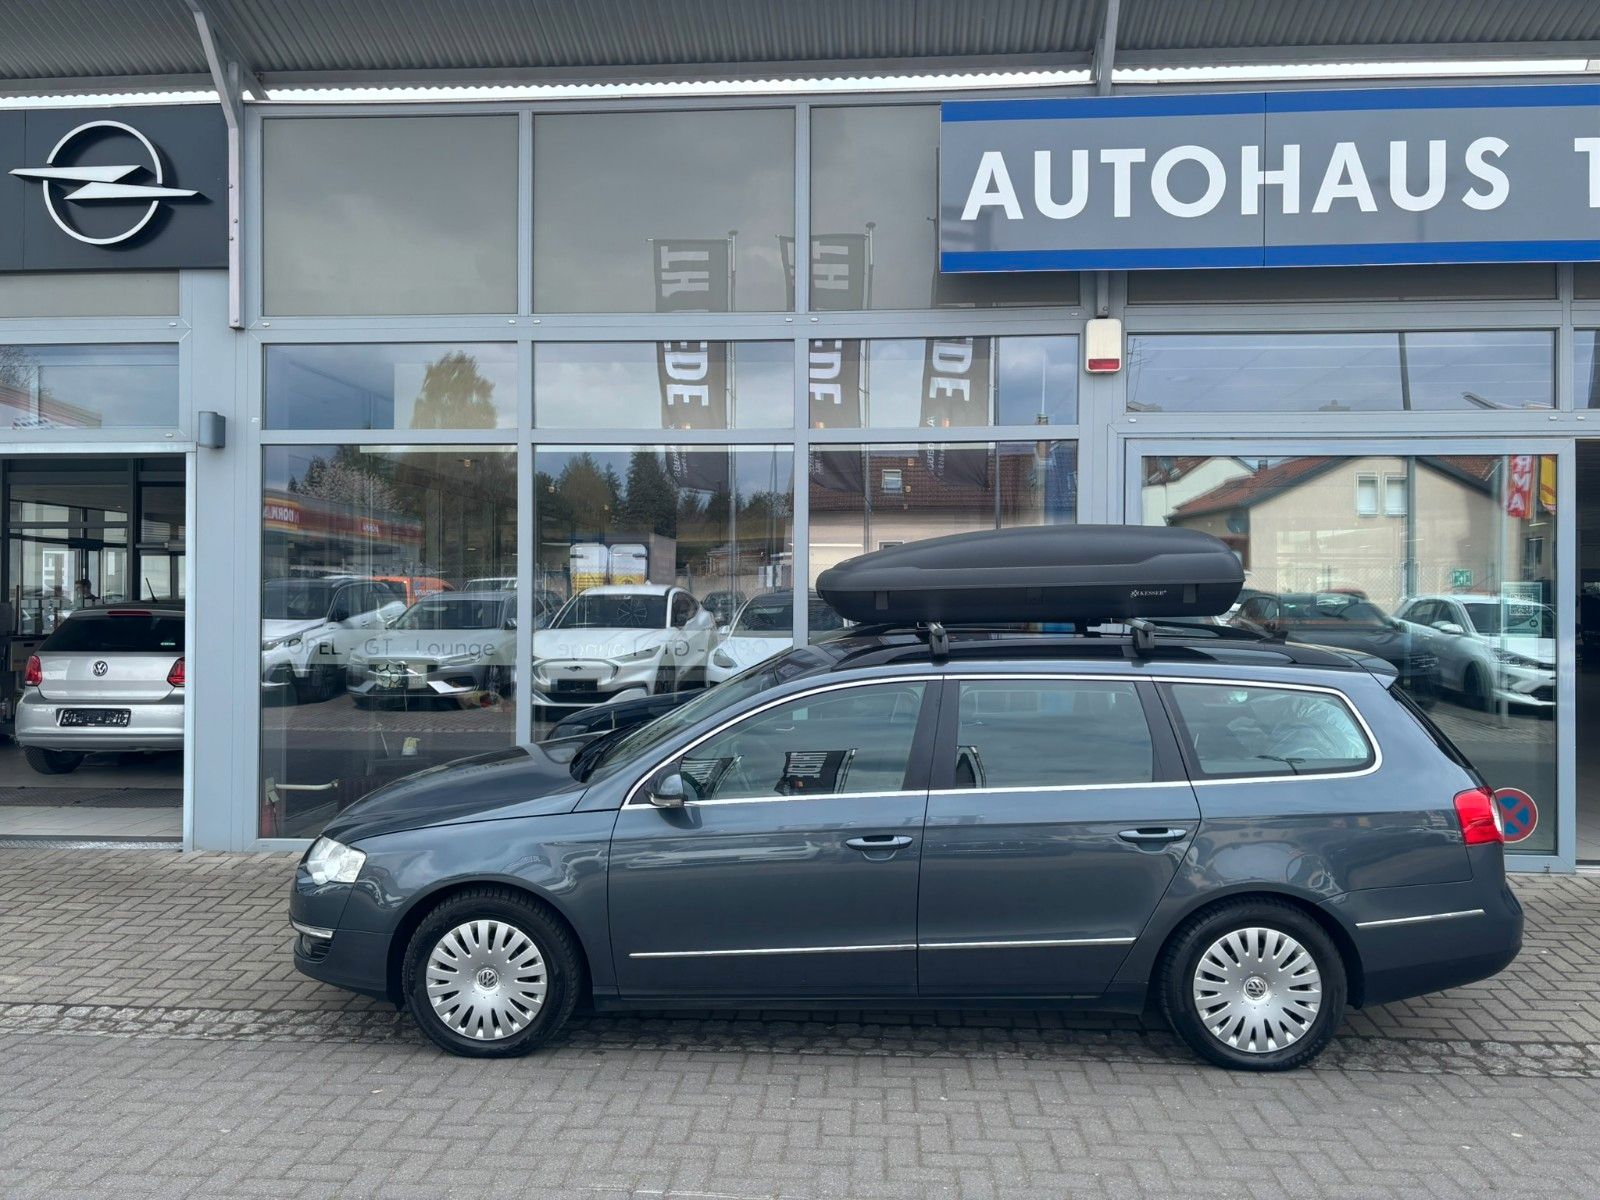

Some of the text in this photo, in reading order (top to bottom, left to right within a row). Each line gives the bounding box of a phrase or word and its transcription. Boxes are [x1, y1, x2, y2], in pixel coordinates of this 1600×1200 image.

[960, 136, 1509, 221] AUTOHAUS
[288, 638, 342, 656] OPEL
[364, 638, 393, 655] GT
[416, 639, 495, 660] Lounge
